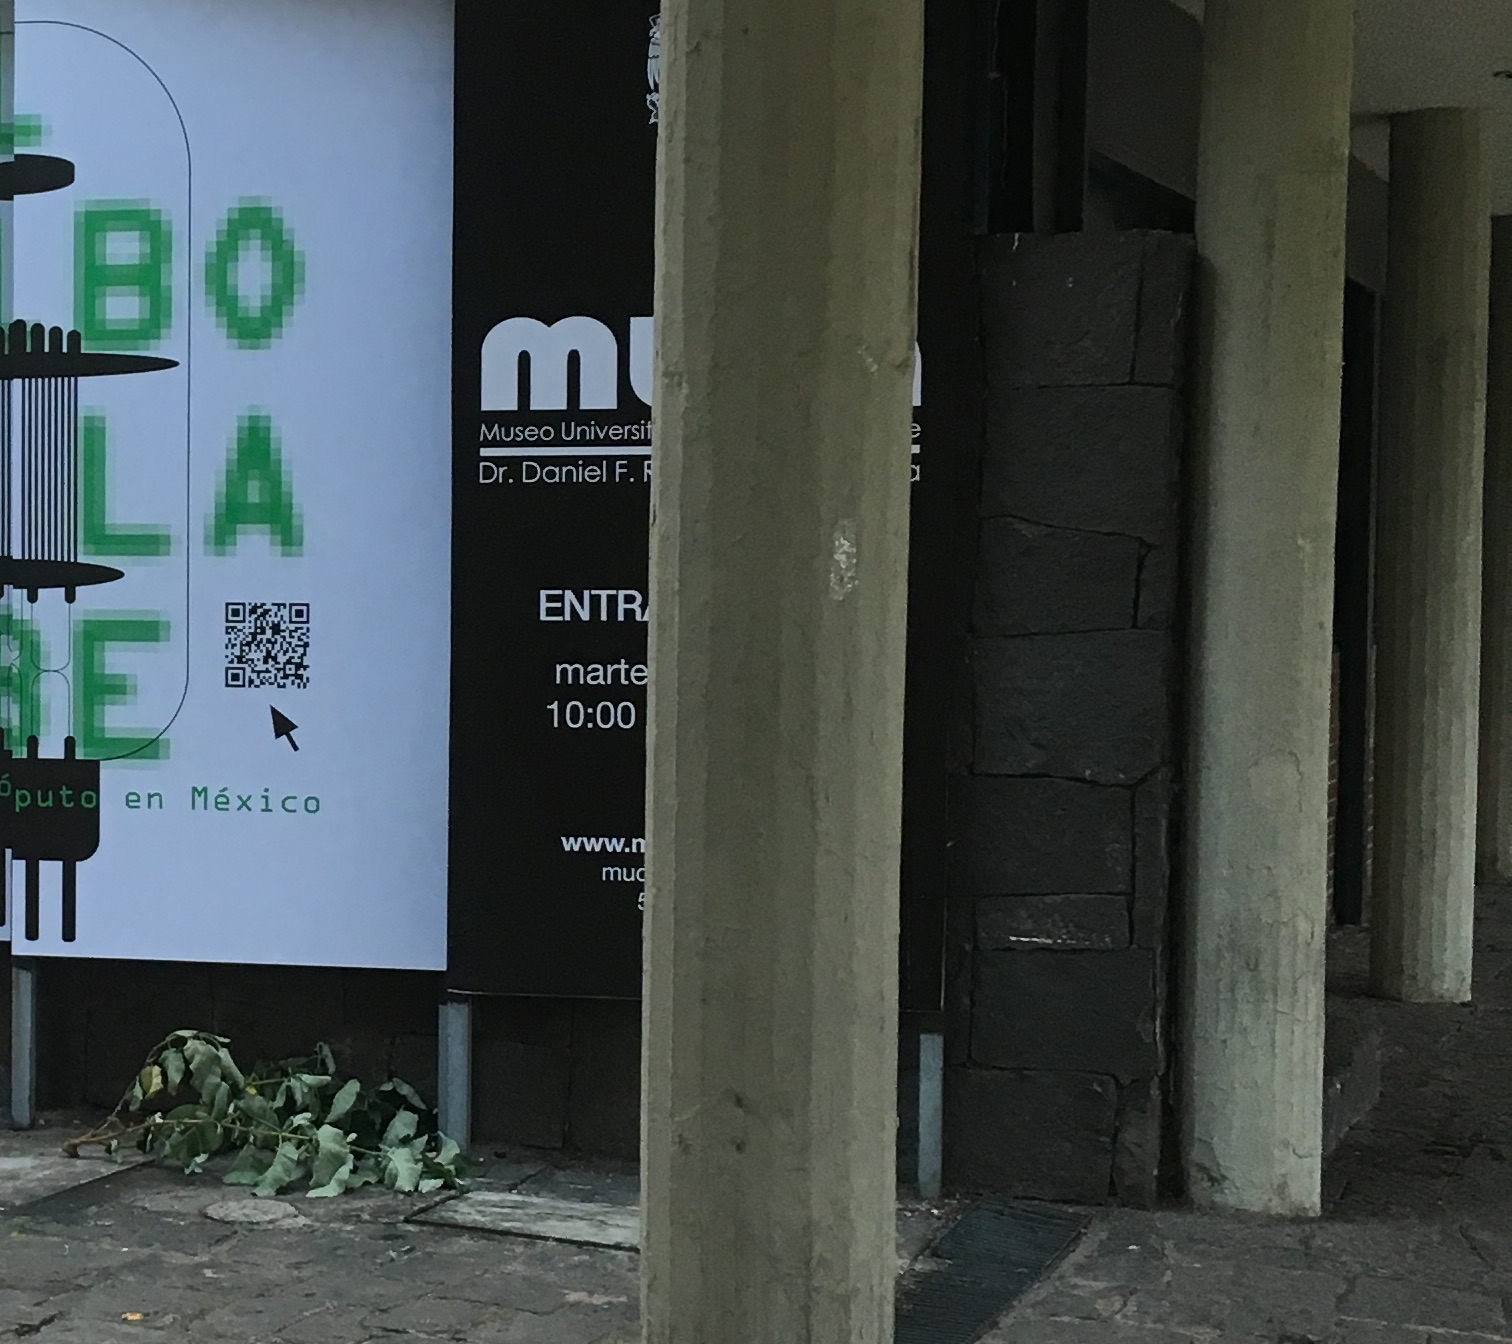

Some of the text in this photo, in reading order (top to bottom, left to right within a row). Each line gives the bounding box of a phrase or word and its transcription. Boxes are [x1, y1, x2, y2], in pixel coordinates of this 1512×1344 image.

[479, 422, 555, 442] Museo
[76, 402, 305, 558] LA
[478, 461, 514, 484] Dr.
[521, 460, 607, 483] Daniel
[616, 461, 640, 483] F.
[539, 589, 649, 622] ENTR
[546, 701, 636, 729] 10:00
[125, 789, 164, 811] en
[190, 784, 323, 815] México
